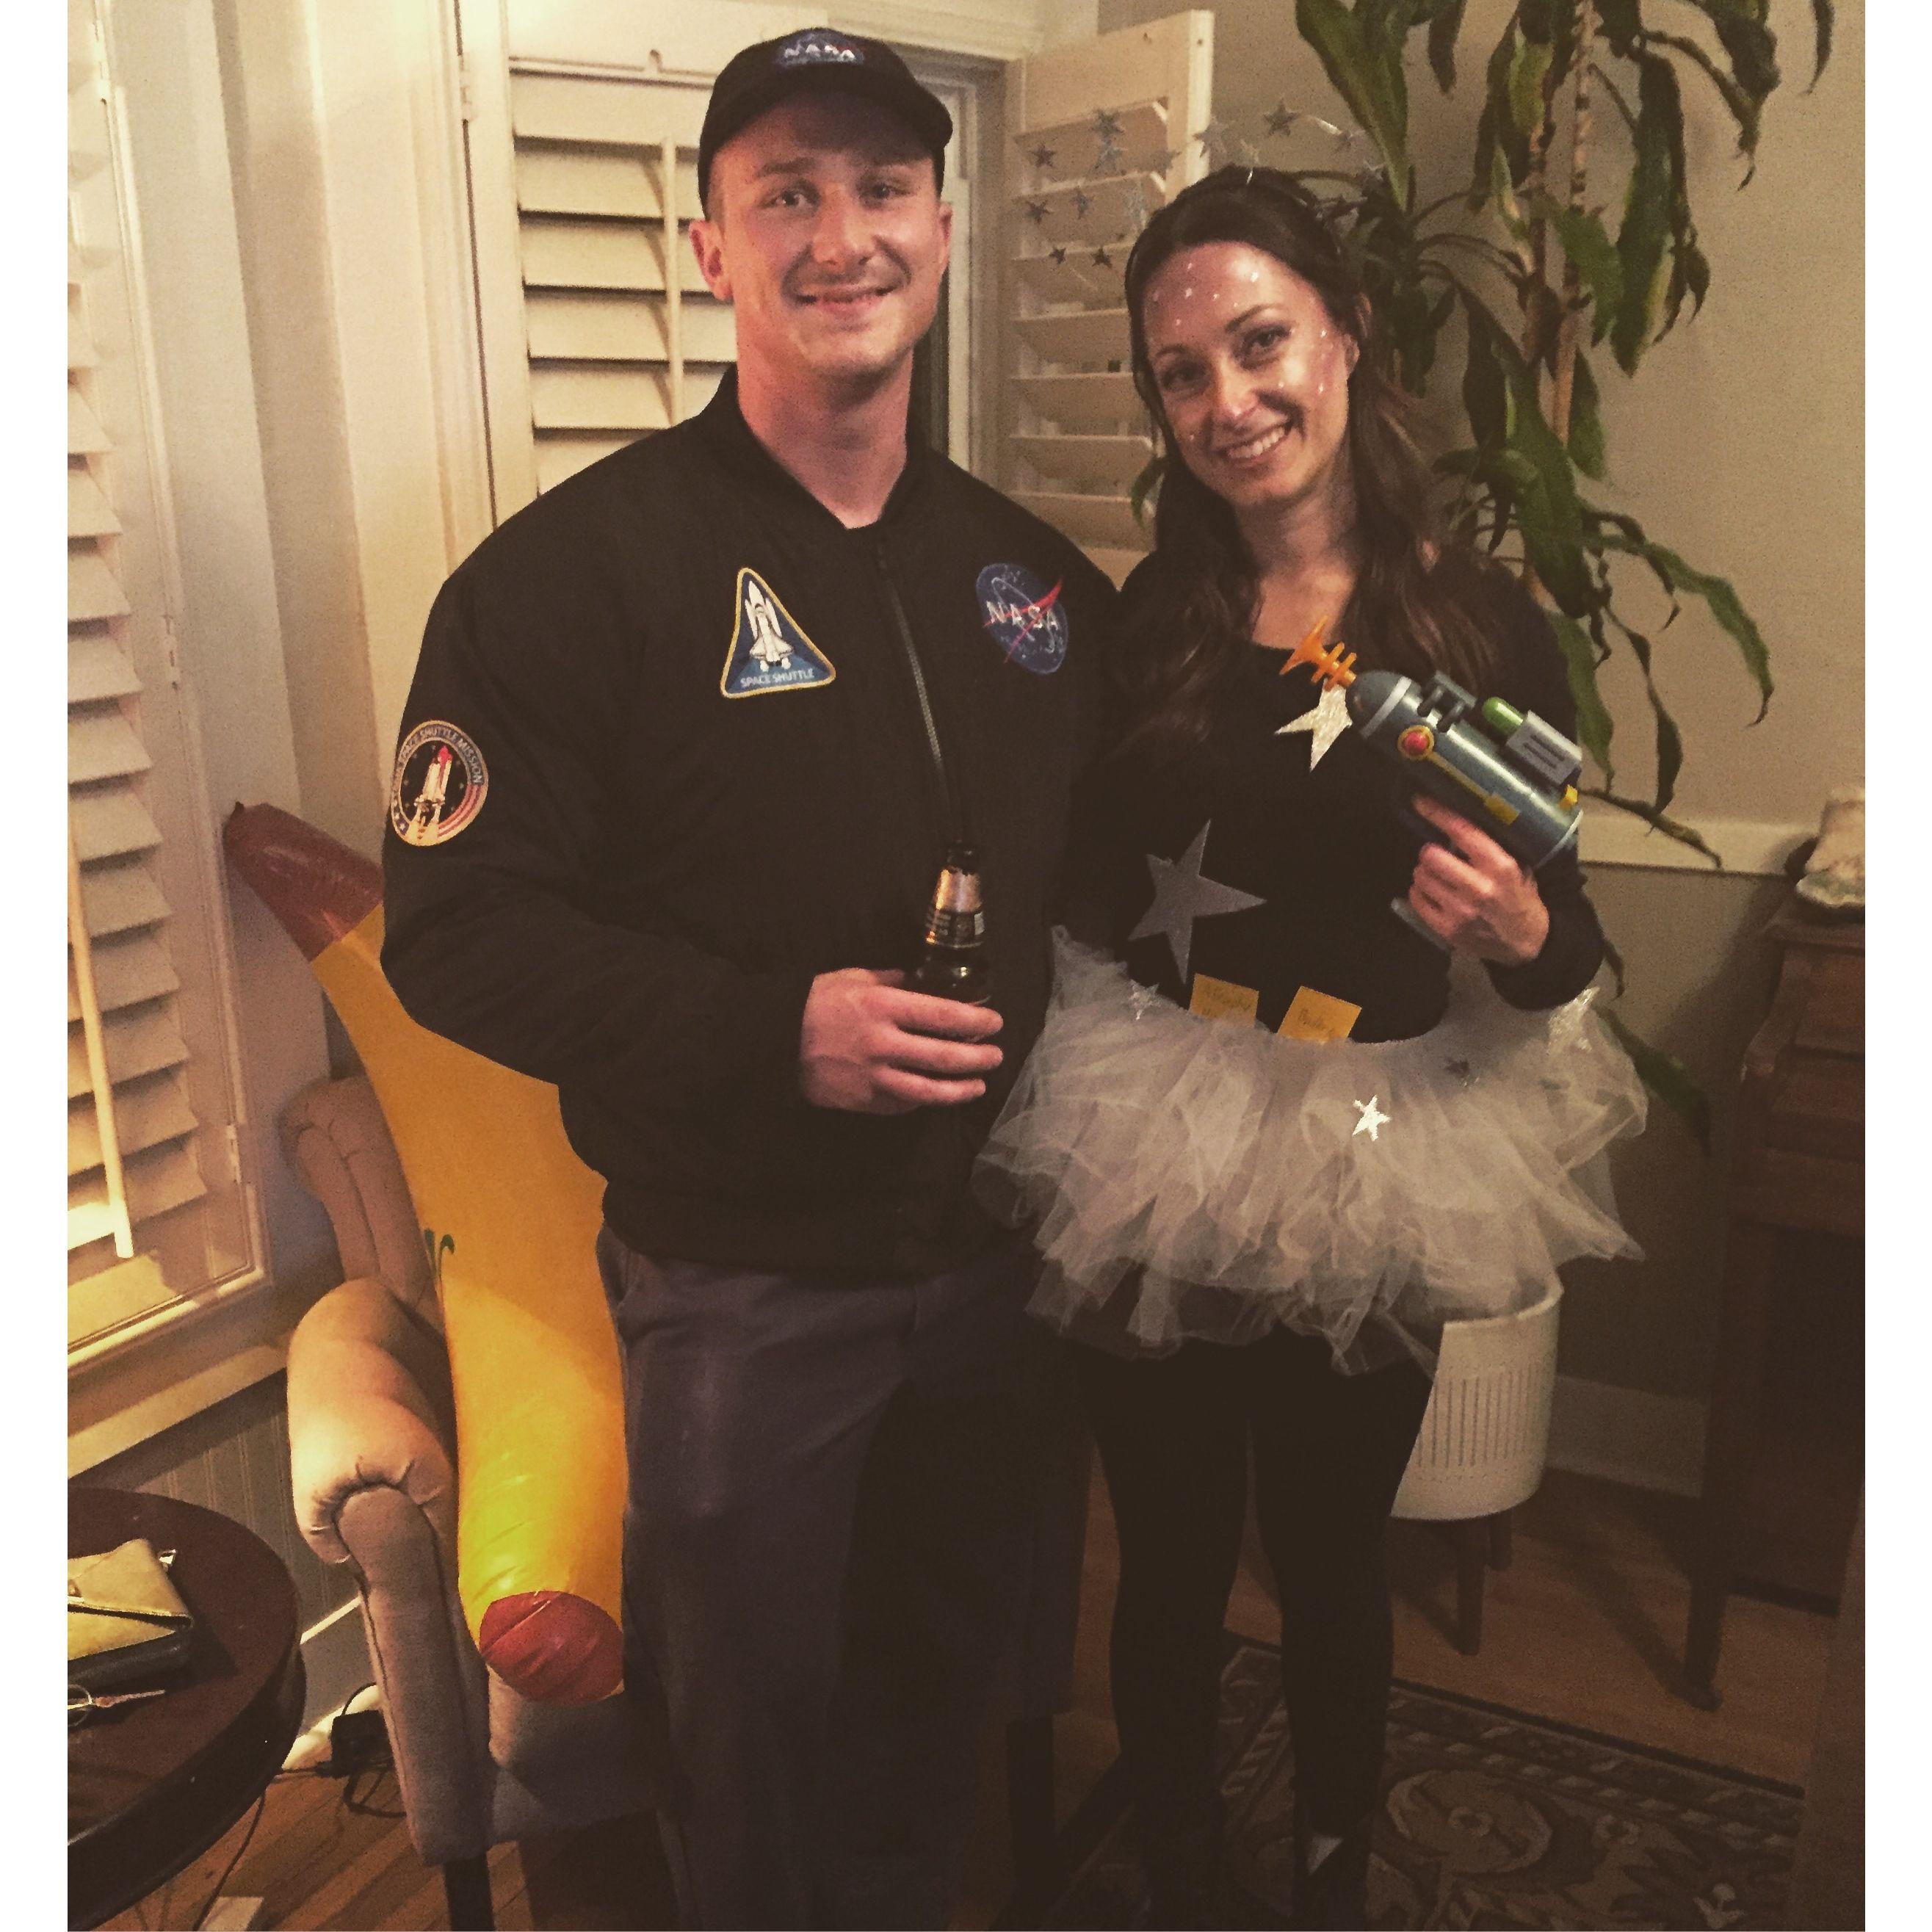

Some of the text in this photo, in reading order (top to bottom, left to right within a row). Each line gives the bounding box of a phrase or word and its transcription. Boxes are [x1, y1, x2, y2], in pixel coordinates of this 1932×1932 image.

[784, 43, 855, 61] NASA
[985, 600, 1059, 632] NASA
[740, 667, 815, 688] SPACE SHUTTLE
[419, 725, 458, 742] SHUTTLE
[459, 739, 483, 784] MISSION
